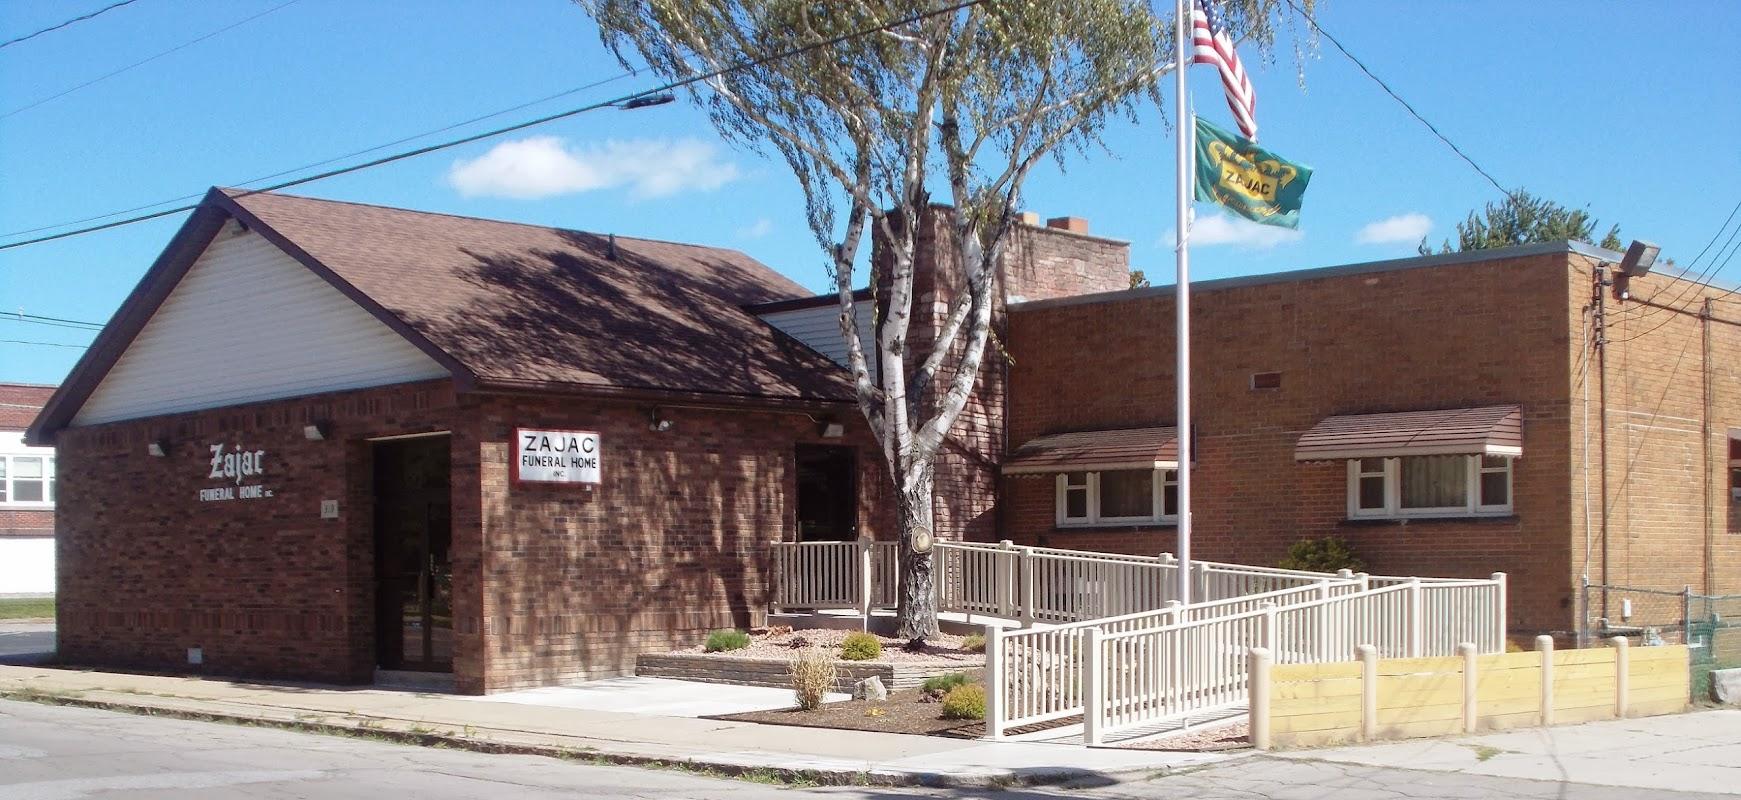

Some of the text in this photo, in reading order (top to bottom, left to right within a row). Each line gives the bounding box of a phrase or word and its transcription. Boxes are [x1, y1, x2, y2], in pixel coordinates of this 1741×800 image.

[1226, 169, 1270, 195] ZAJAC
[525, 435, 594, 453] ZAJAC
[208, 443, 264, 485] Zajac
[522, 455, 596, 469] FUNERAL HOME
[200, 487, 234, 501] FUNERAL
[240, 485, 263, 499] HOME
